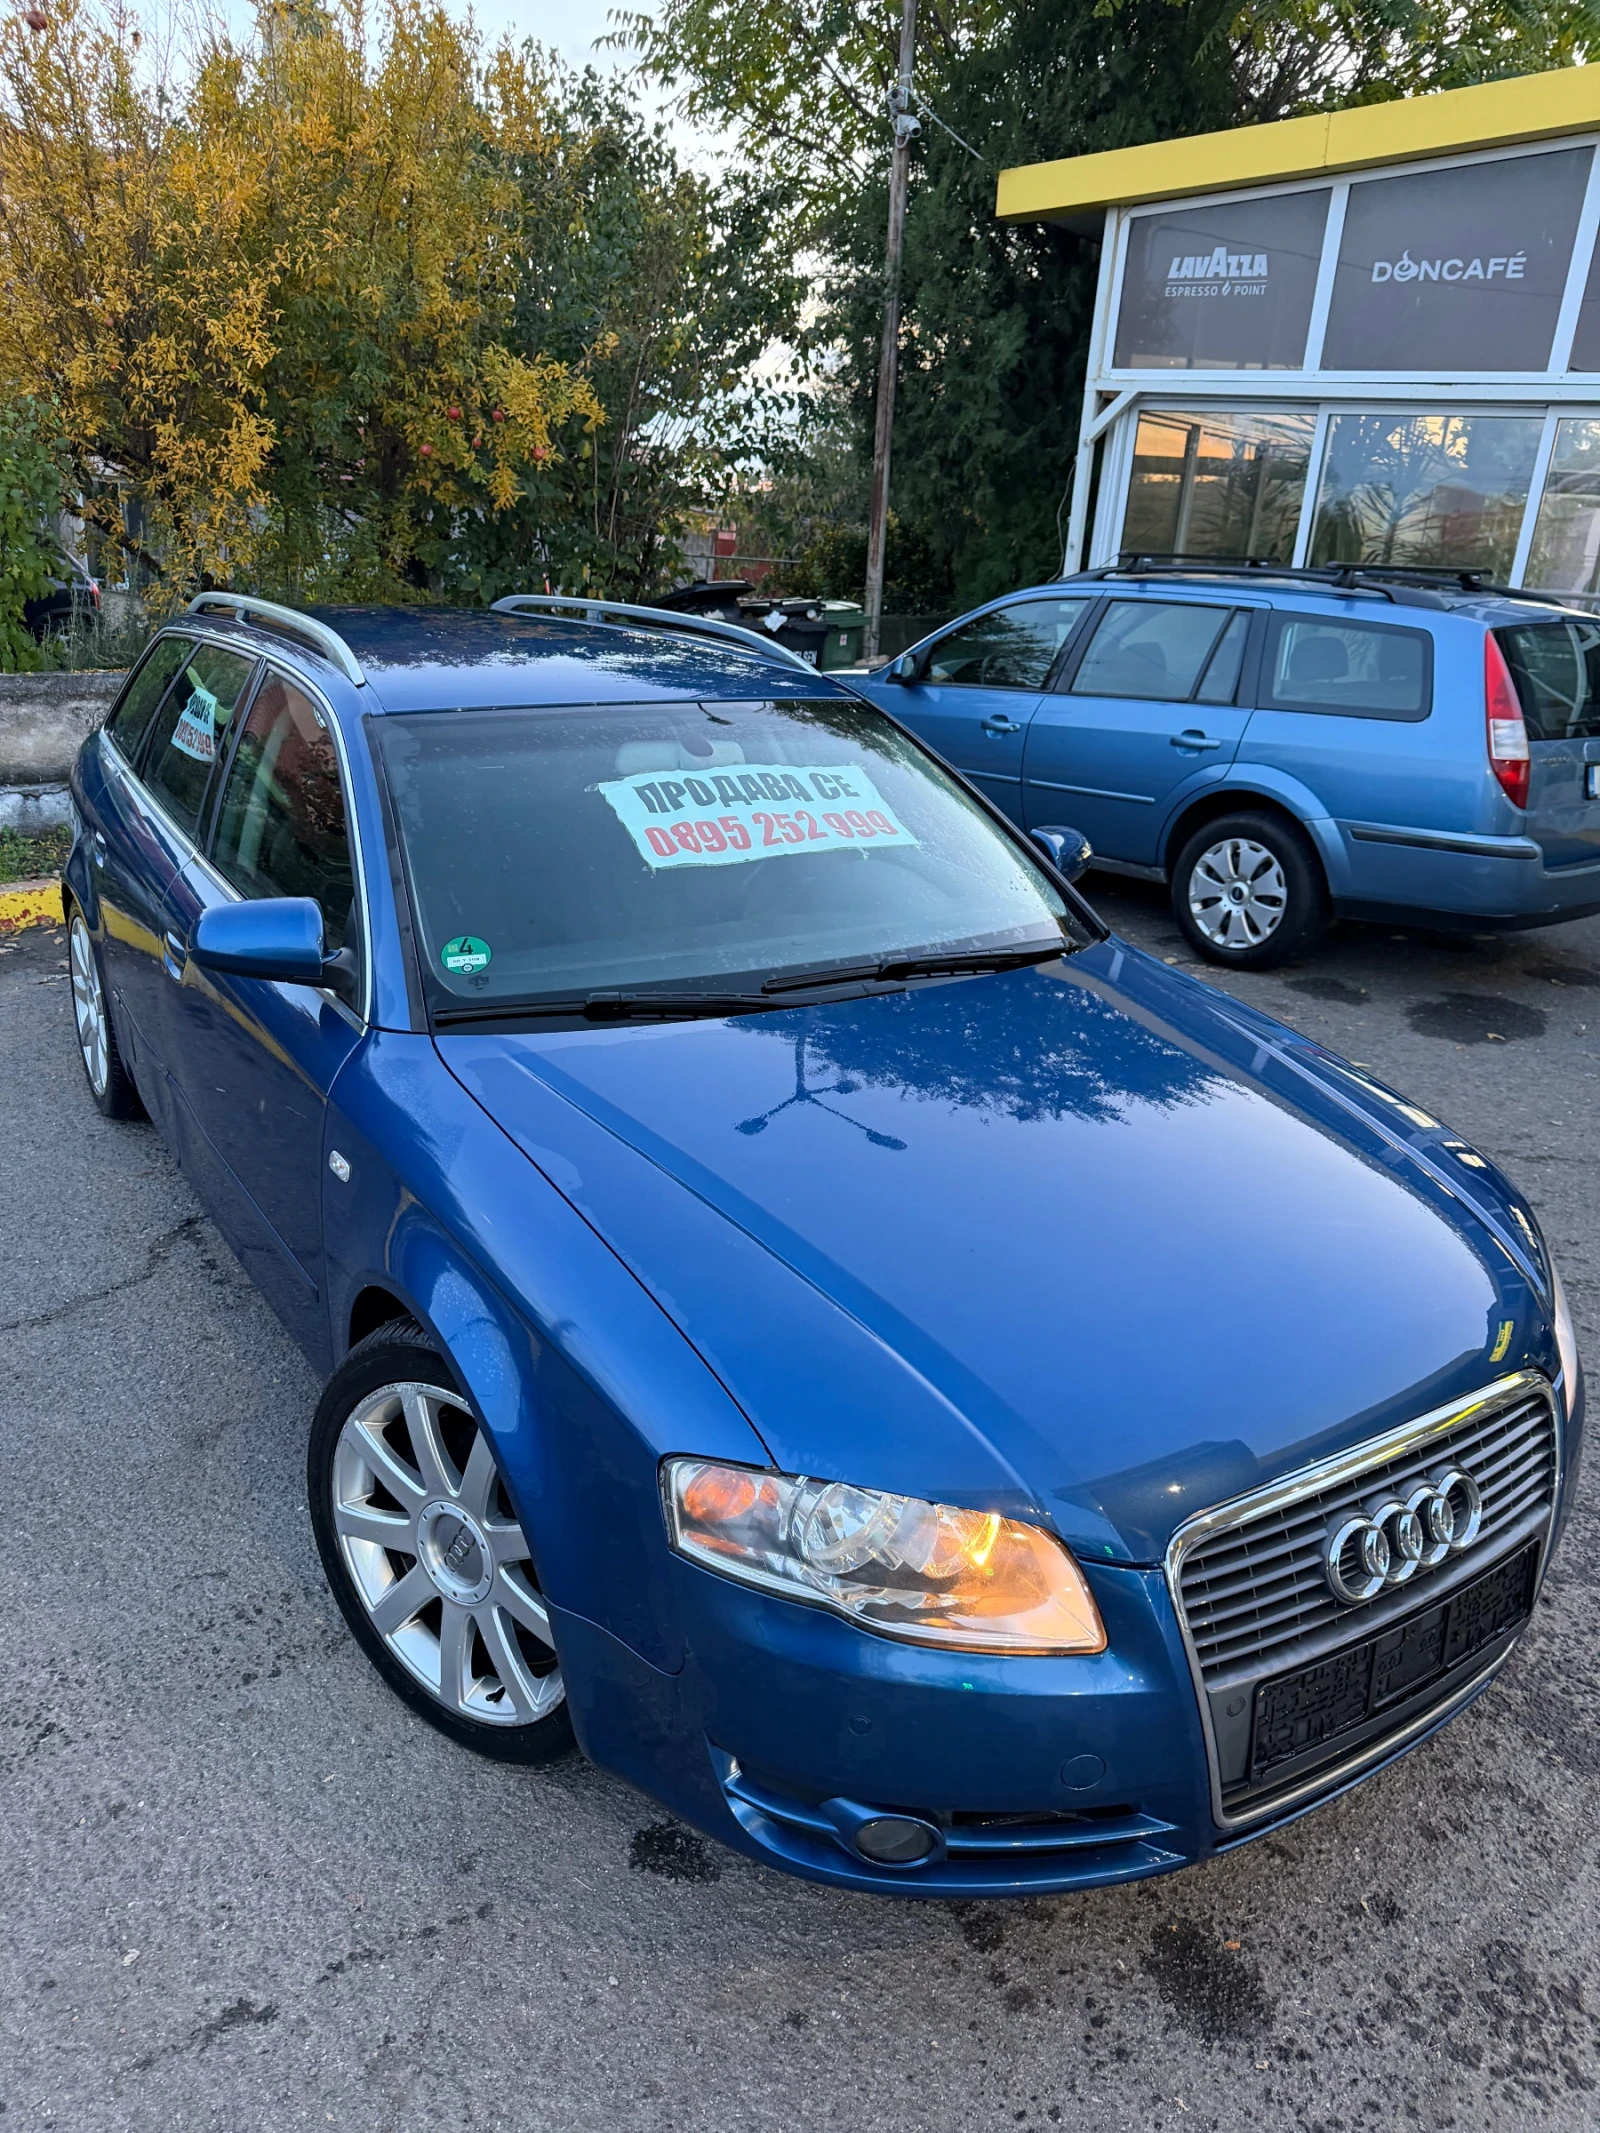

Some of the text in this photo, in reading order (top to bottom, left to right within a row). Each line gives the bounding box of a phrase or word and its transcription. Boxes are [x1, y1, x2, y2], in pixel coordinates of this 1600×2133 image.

[1168, 246, 1268, 279] LAVAZZA
[1371, 250, 1527, 283] DONCAFÉ
[1165, 285, 1267, 297] ESPRESSO POINT
[633, 772, 861, 814] ПРОДАВА СЕ
[644, 810, 899, 857] 0895 252 999
[459, 938, 474, 954] 4
